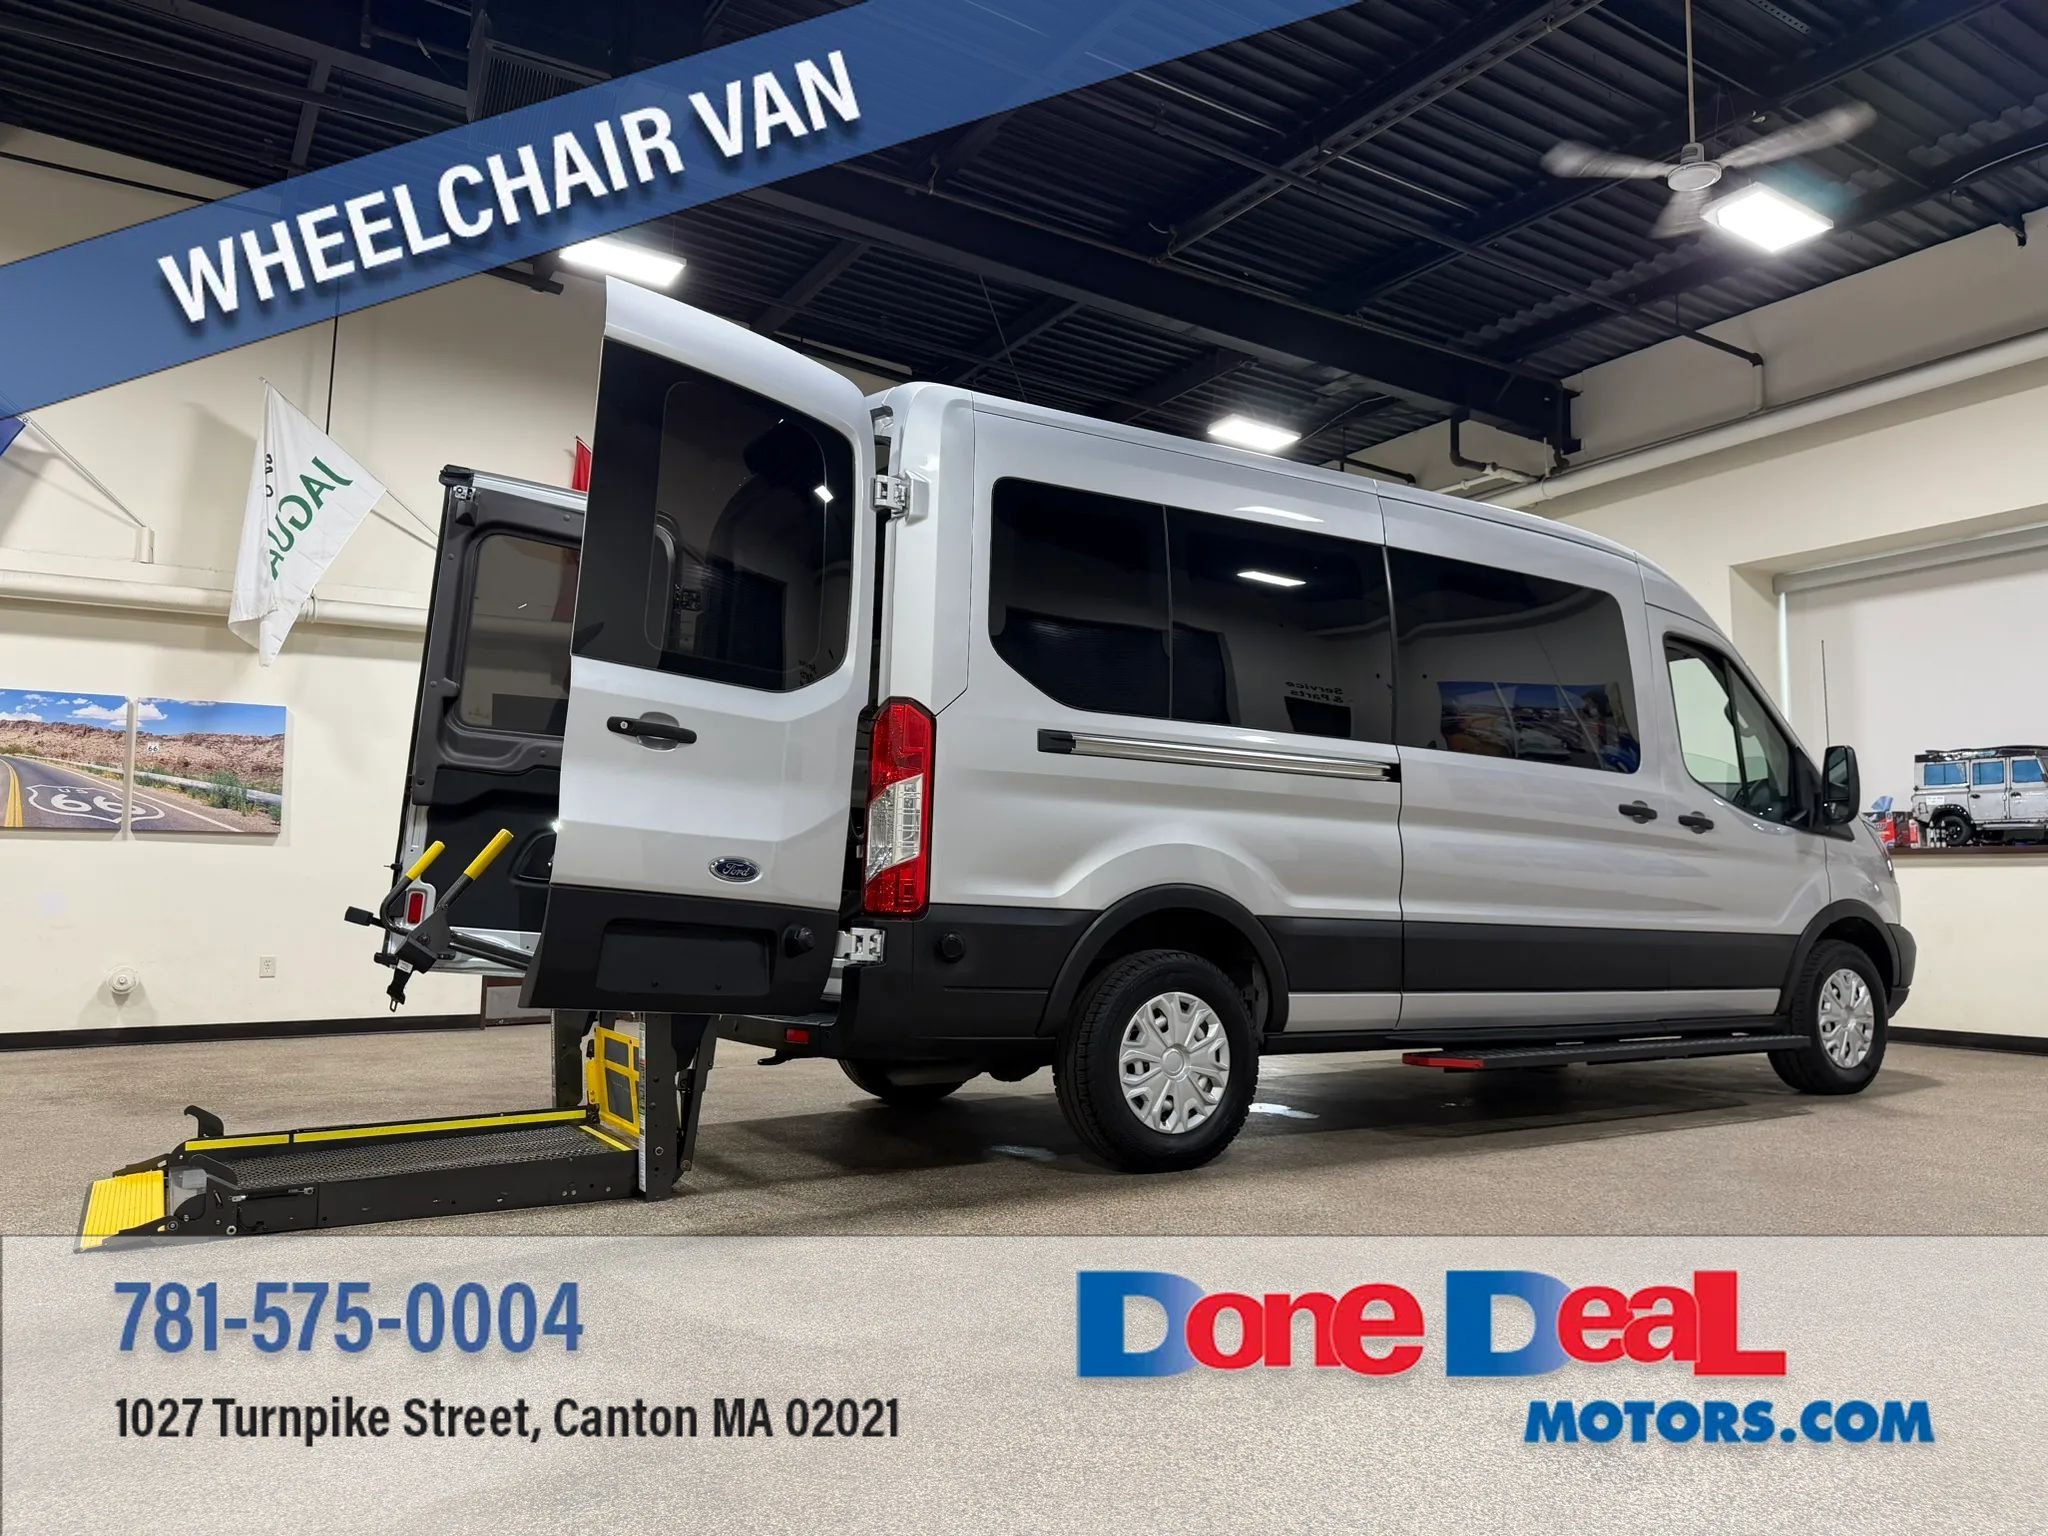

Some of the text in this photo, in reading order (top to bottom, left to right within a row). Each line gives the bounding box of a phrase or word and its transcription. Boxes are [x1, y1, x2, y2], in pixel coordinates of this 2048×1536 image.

[147, 745, 160, 753] 66
[51, 794, 146, 815] 66
[721, 863, 751, 877] Ford
